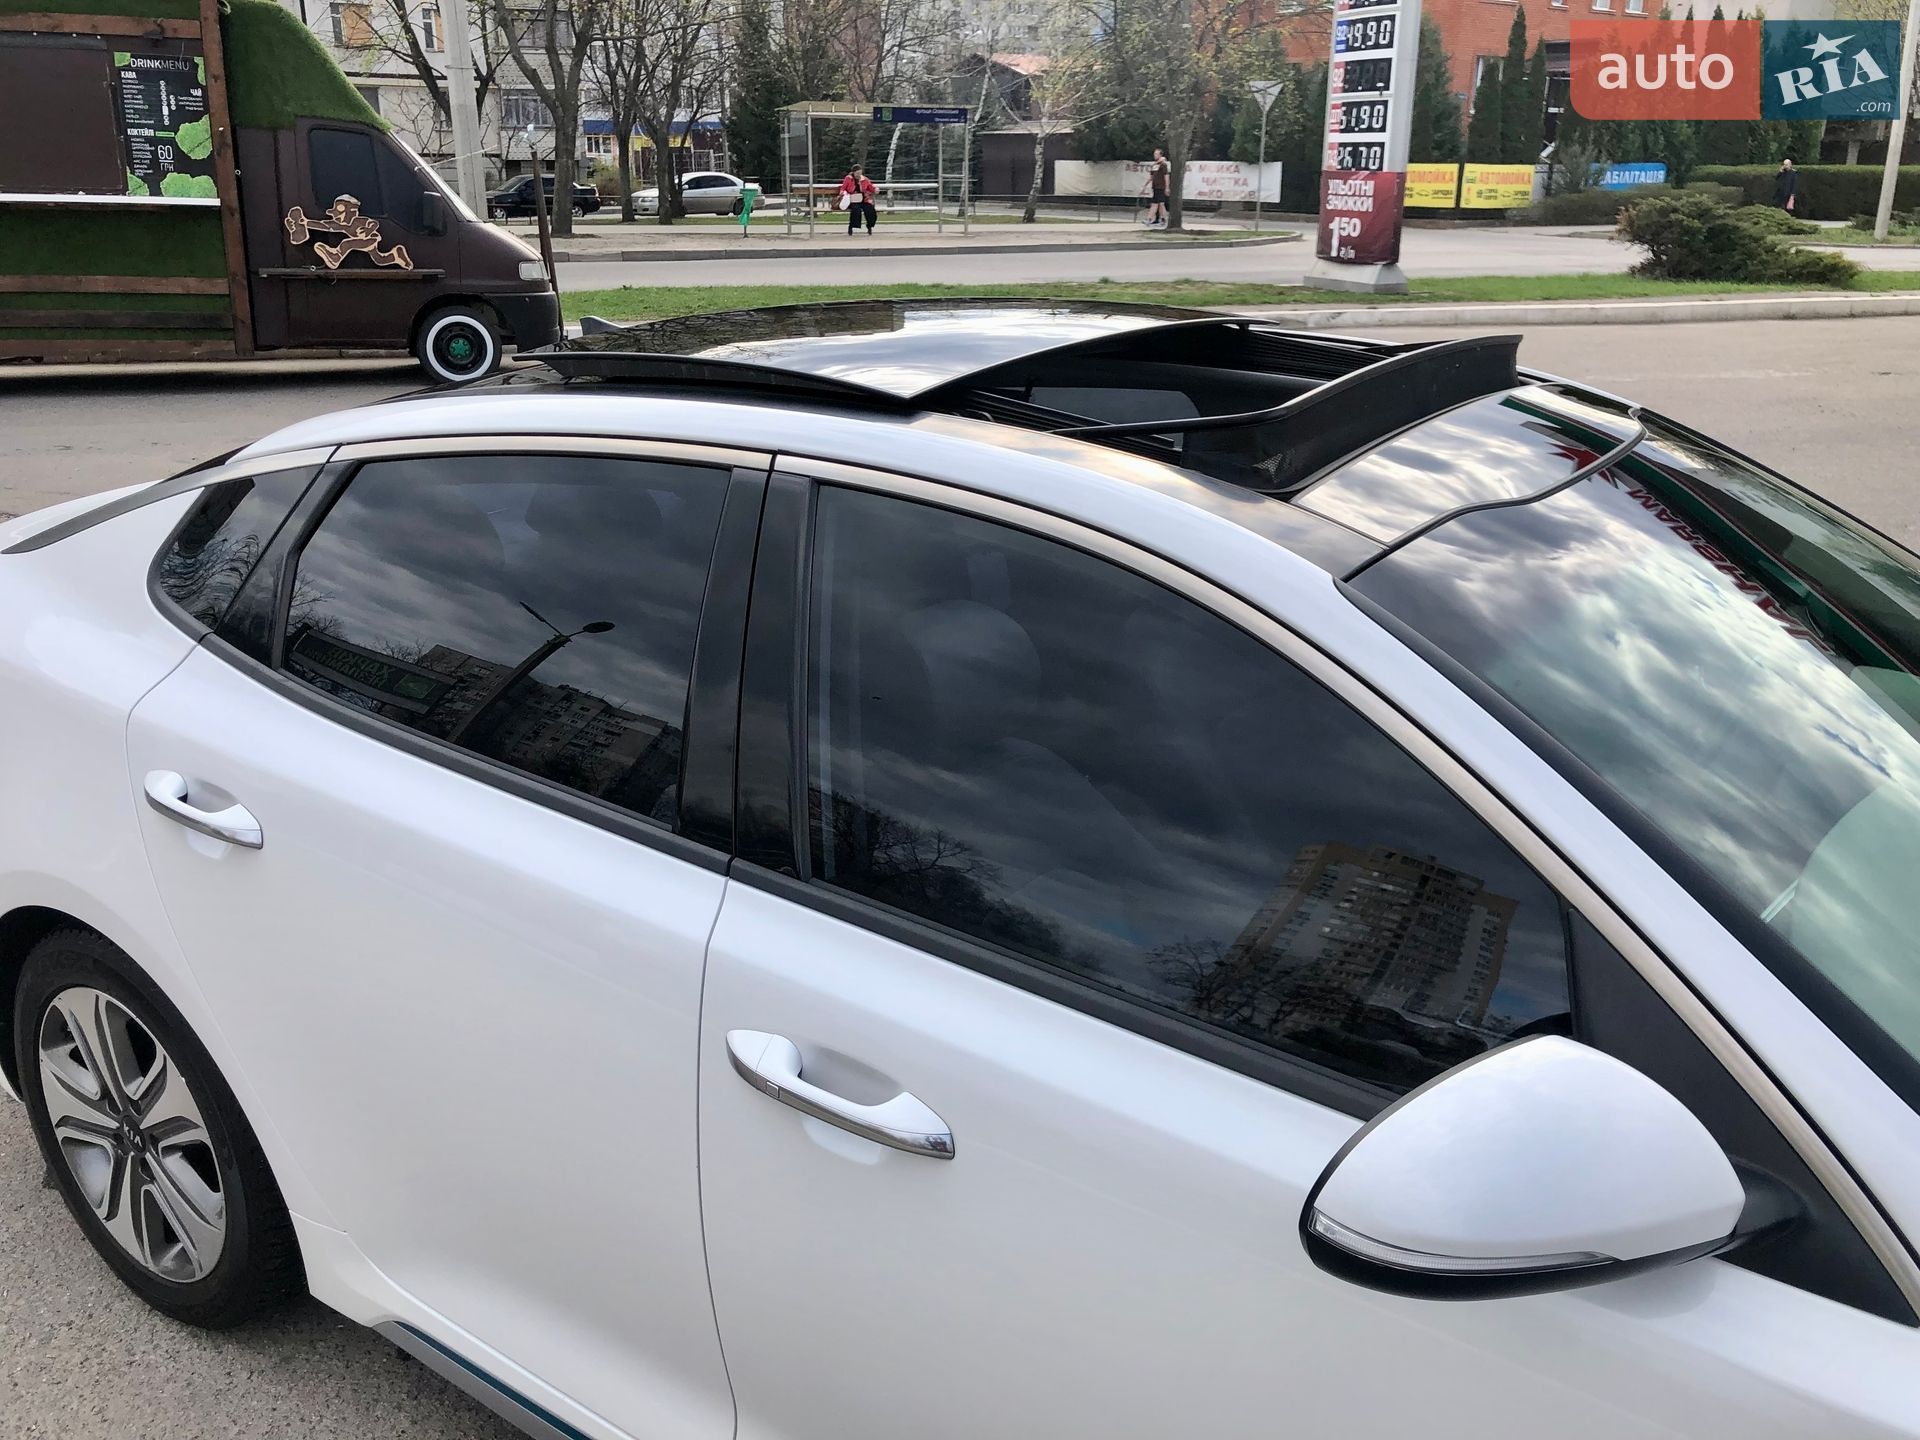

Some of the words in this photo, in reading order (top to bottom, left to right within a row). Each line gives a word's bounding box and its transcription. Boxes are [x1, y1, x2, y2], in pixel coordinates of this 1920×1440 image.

[121, 71, 137, 79] КАВА
[190, 88, 202, 97] ЧАЙ
[157, 145, 173, 160] 60
[160, 162, 174, 171] ГРН
[1600, 169, 1667, 185] АБІЛІТАЦІЯ
[123, 1120, 143, 1148] KIA
